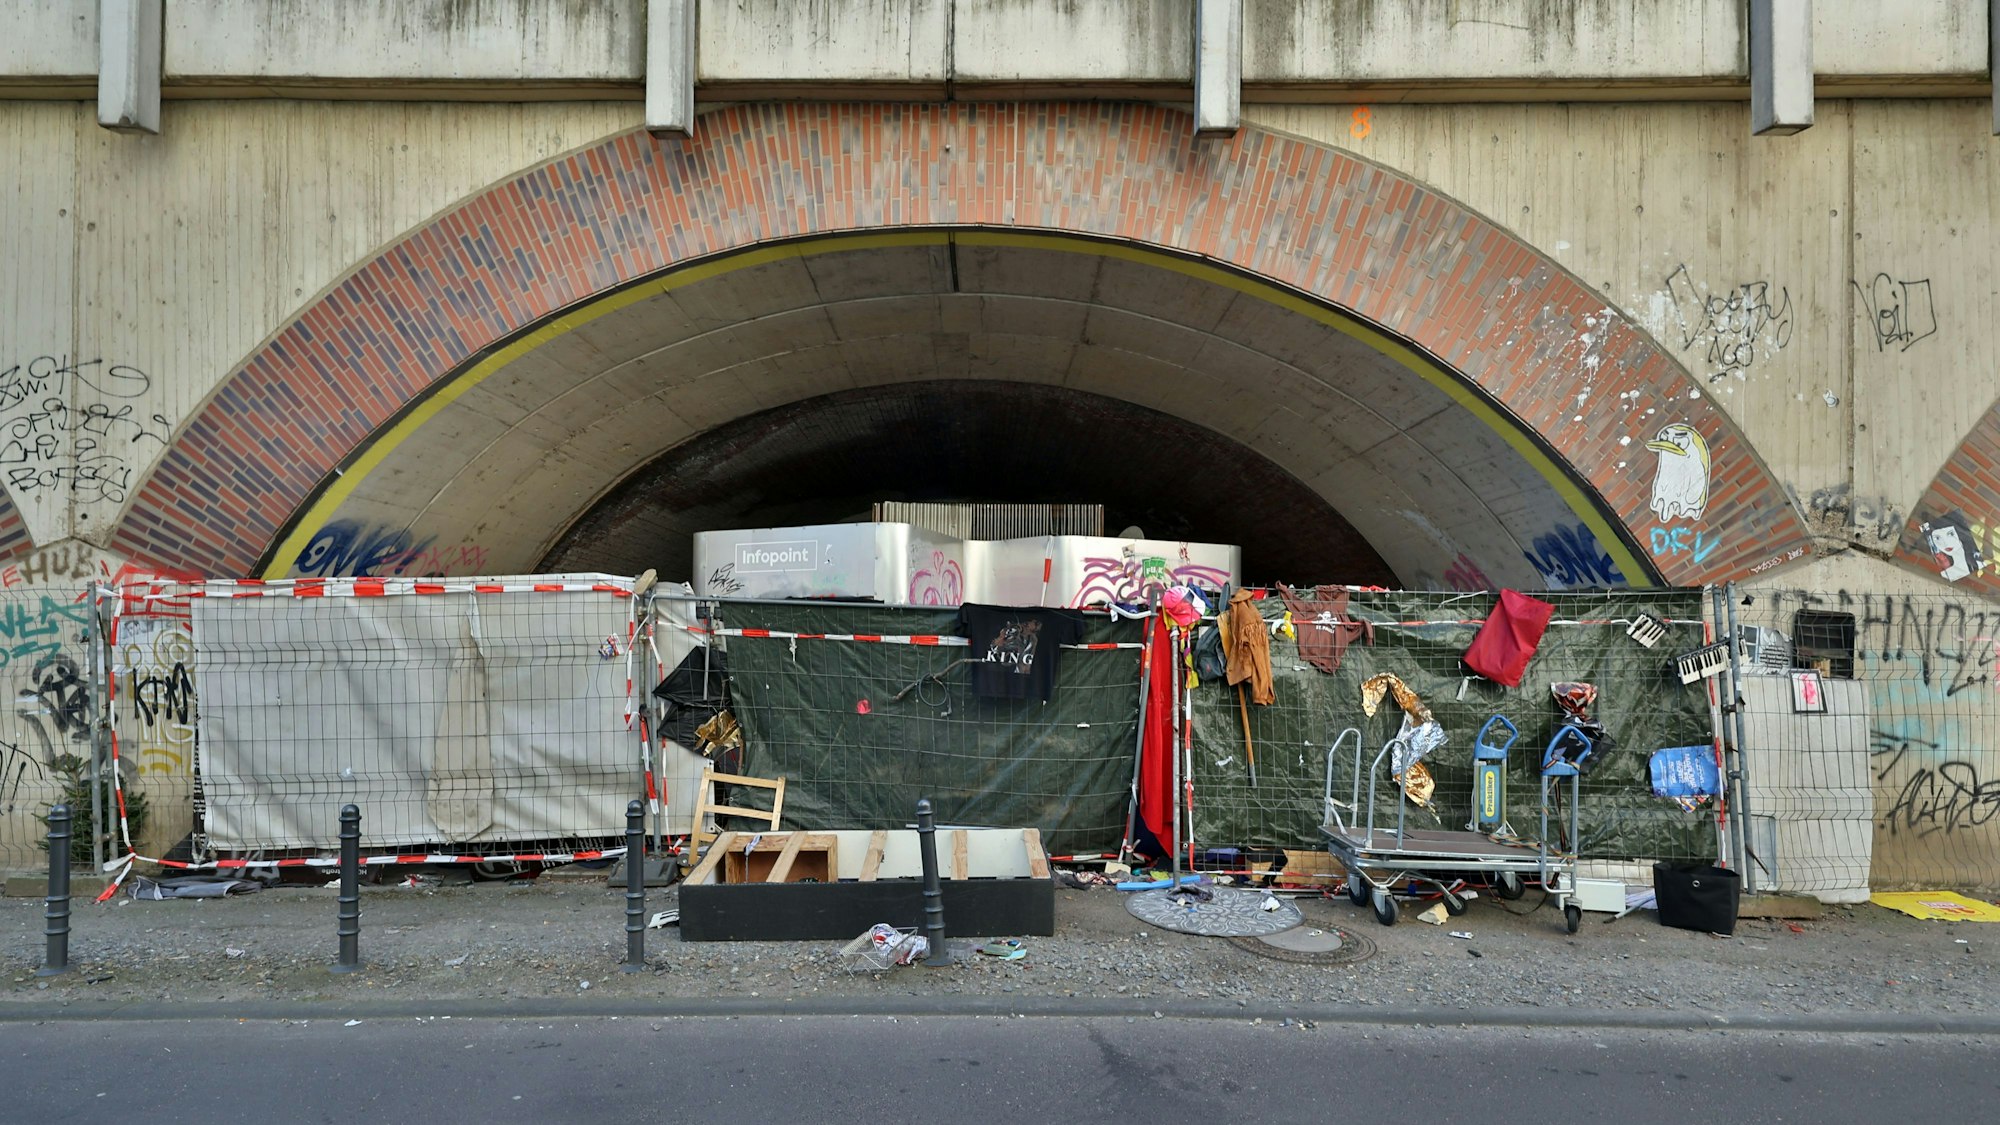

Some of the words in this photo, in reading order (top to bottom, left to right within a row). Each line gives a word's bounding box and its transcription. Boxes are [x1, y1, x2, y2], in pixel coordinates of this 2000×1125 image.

[1349, 105, 1373, 139] 8
[743, 548, 808, 566] Infopoint
[986, 650, 1034, 665] KING
